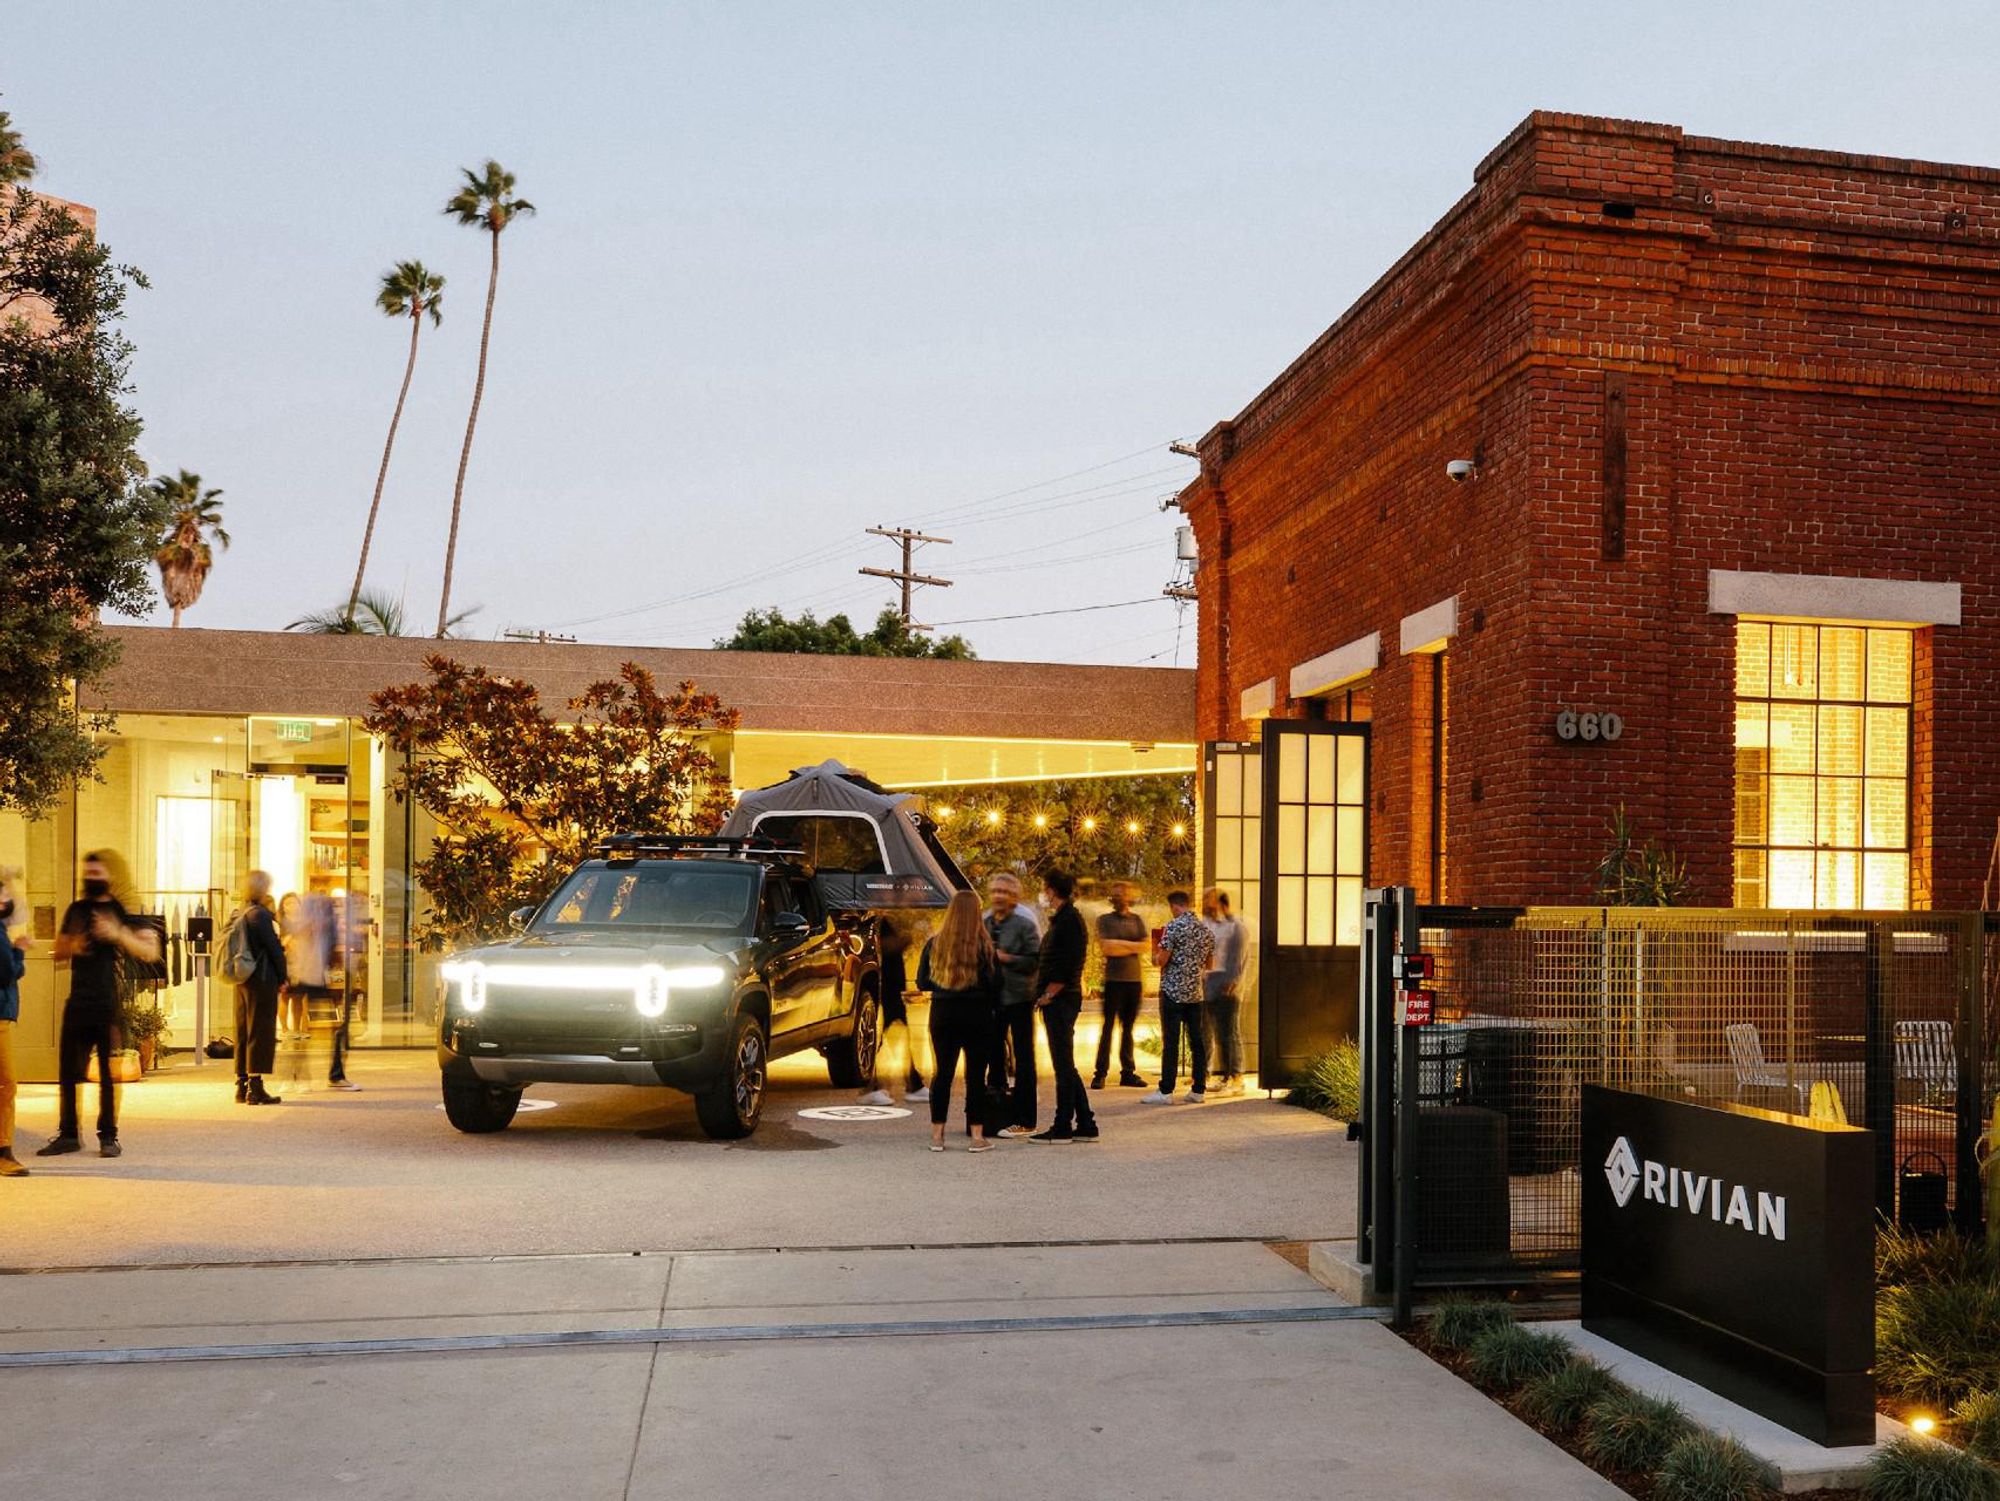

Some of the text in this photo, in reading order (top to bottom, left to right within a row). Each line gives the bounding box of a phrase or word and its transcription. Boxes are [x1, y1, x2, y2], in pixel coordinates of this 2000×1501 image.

[1557, 710, 1622, 741] 660
[1408, 1000, 1430, 1009] FIRE
[1644, 1160, 1787, 1241] RIVIAN
